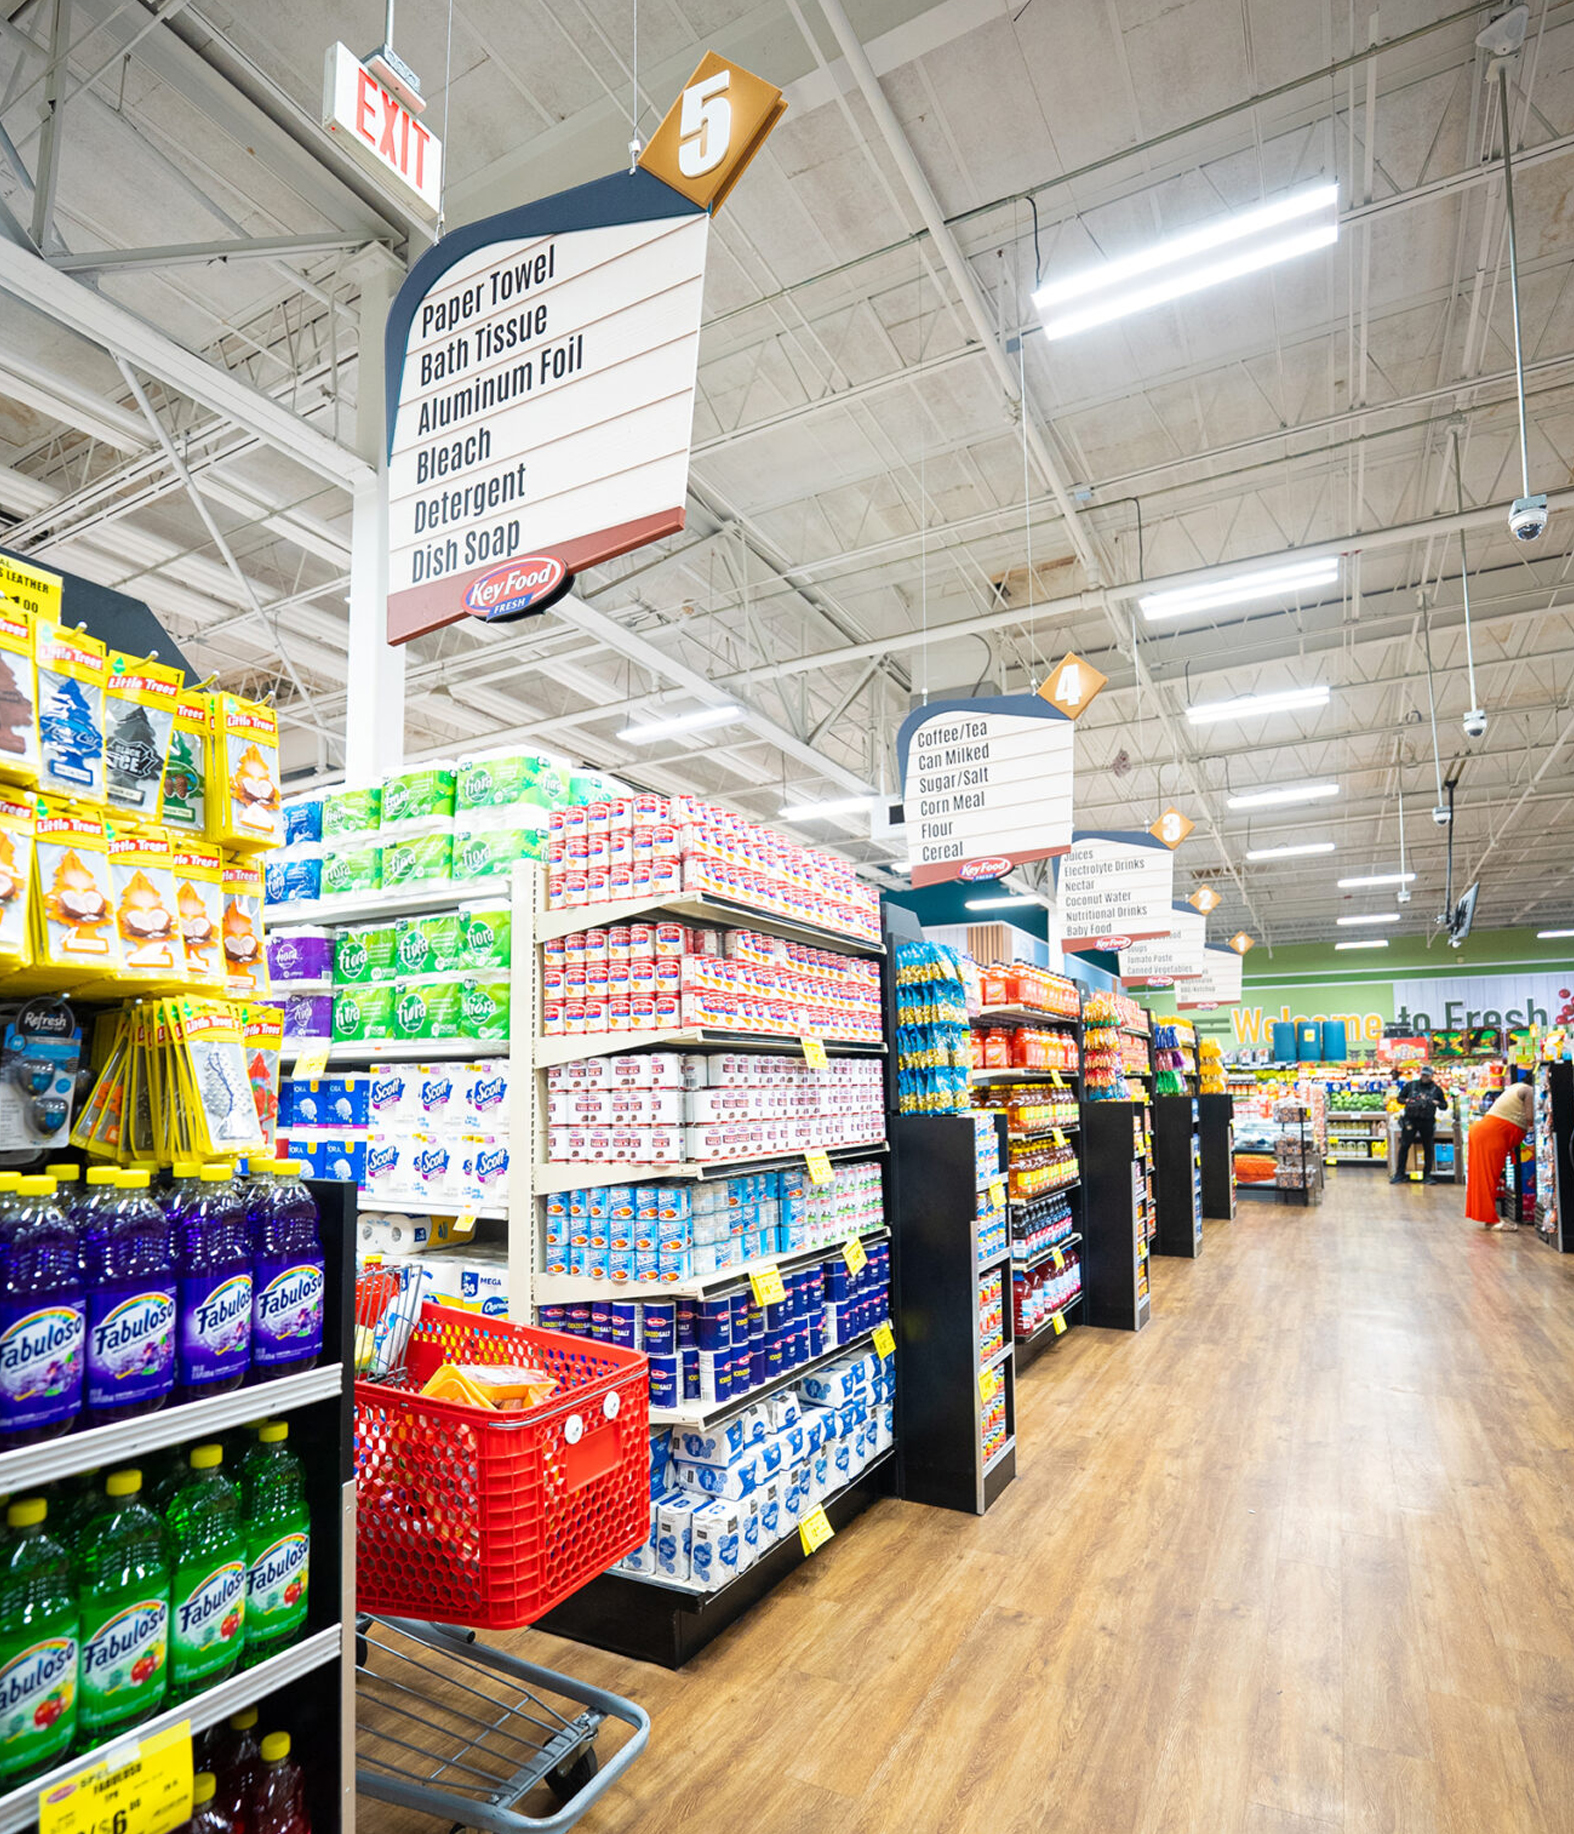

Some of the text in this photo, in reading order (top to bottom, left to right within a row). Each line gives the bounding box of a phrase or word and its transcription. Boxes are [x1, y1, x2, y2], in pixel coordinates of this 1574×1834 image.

[356, 67, 430, 190] EXIT
[678, 71, 731, 178] 5
[421, 245, 556, 339] Paper Towel
[420, 304, 548, 387] Bath Tissue
[417, 335, 584, 437] Aluminum Foil
[417, 429, 491, 485] Bleach
[413, 463, 526, 535] Detergent
[412, 518, 521, 583] Dish Soap
[7, 570, 50, 594] LEATHER
[23, 599, 39, 613] 00
[494, 597, 526, 614] FRESH
[72, 650, 103, 671] Trees
[108, 675, 177, 696] Little Trees
[1055, 664, 1082, 706] 4
[178, 704, 205, 720] Trees
[227, 714, 275, 732] Little Trees
[917, 721, 988, 748] Coffee/Tea
[918, 743, 990, 771] Can Milked
[464, 774, 493, 796] fiora
[919, 767, 989, 794] Sugar/Salt
[920, 791, 986, 817] Corn Meal
[37, 818, 102, 834] Little Trees
[921, 820, 954, 839] Flour
[1162, 813, 1180, 842] 3
[137, 839, 168, 852] Trees
[922, 841, 964, 862] Cereal
[190, 854, 218, 868] Trees
[1064, 859, 1145, 877] Electrolyte Drinks
[235, 870, 258, 882] Trees
[1065, 880, 1094, 892] Nectar
[1066, 891, 1131, 907] Coconut Water
[1199, 889, 1212, 910] 2
[1066, 905, 1147, 922] Nutritional Drinks
[467, 927, 494, 946] fiora
[1067, 922, 1112, 936] Baby Food
[1236, 936, 1245, 952] 1
[338, 948, 368, 967] fiora
[25, 1011, 66, 1030] Refresh
[397, 1000, 427, 1021] fiora
[186, 1018, 210, 1034] Little
[260, 1023, 281, 1035] Trees
[374, 1077, 401, 1100] Scott
[424, 1078, 450, 1102] Scott
[477, 1076, 504, 1101] Scott
[369, 1146, 396, 1169] Scott
[422, 1149, 447, 1171] Scott
[478, 1148, 507, 1173] Scott
[480, 1277, 501, 1286] MEGA
[258, 1272, 323, 1320] Fabuloso
[197, 1287, 251, 1335] Fabulos
[94, 1300, 175, 1356] Fabuloso
[83, 1604, 166, 1674] Fabuloso
[0, 1641, 75, 1708] abuloso
